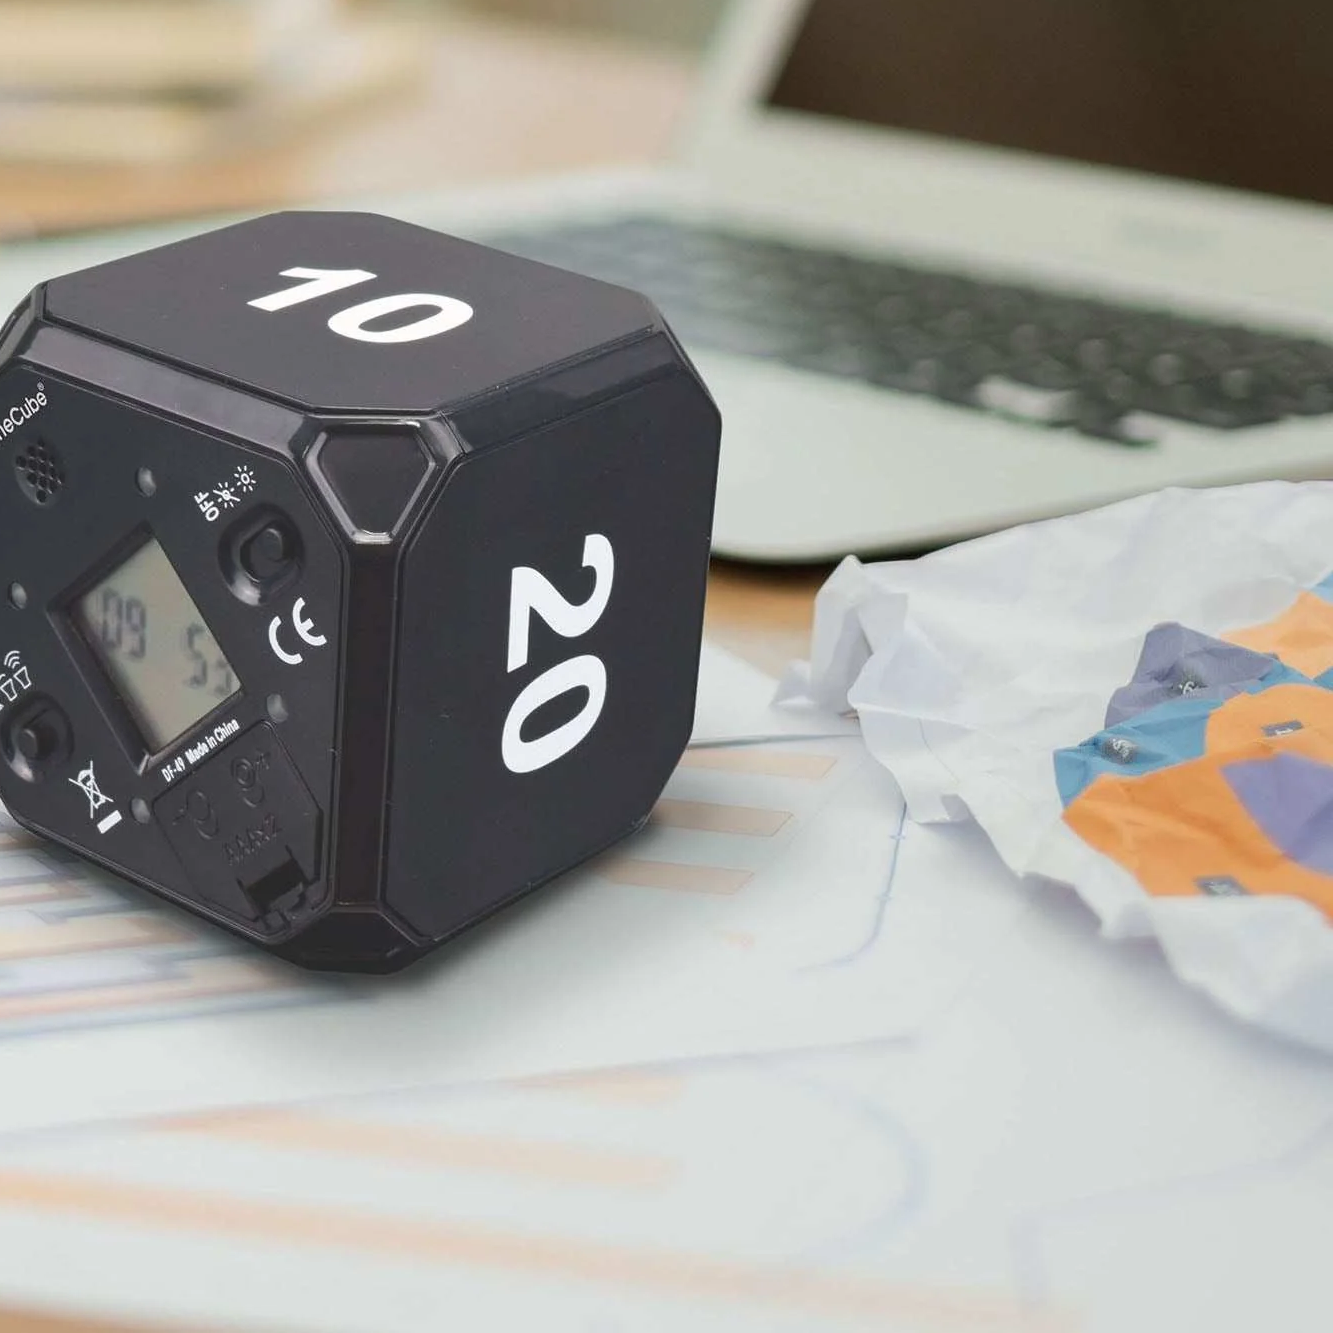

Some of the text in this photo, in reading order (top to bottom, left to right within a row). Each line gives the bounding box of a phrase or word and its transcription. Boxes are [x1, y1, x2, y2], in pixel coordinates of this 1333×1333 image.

[246, 266, 474, 343] 10
[193, 491, 220, 522] OFF
[268, 596, 328, 665] CE
[501, 533, 615, 774] 20
[184, 741, 210, 765] Made
[204, 735, 218, 749] in
[213, 718, 241, 743] China
